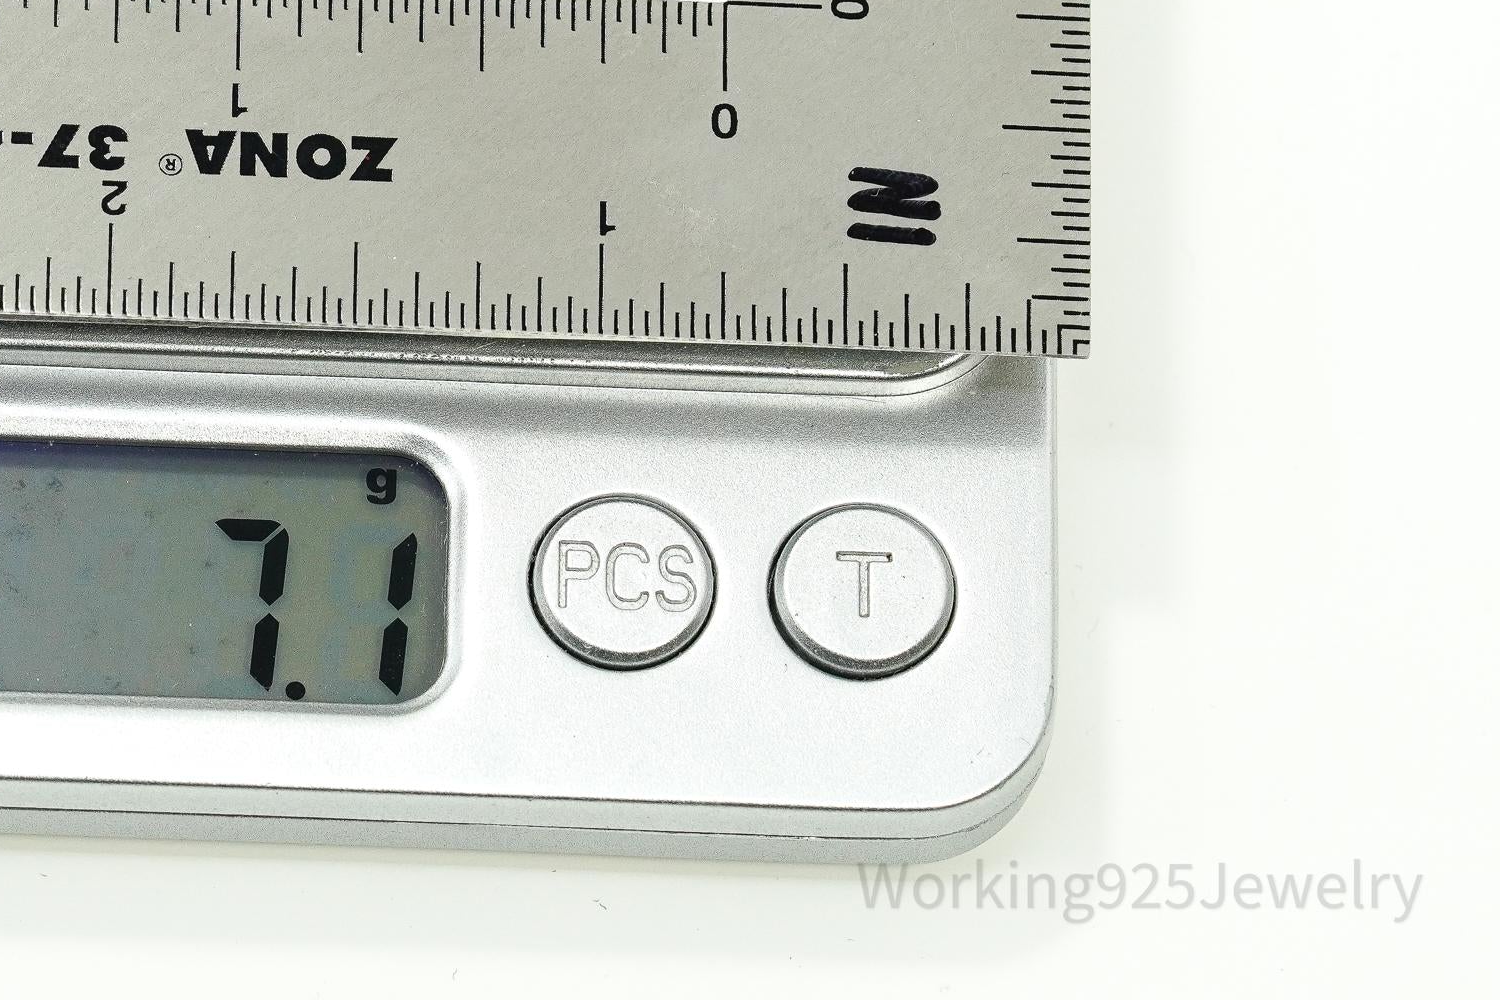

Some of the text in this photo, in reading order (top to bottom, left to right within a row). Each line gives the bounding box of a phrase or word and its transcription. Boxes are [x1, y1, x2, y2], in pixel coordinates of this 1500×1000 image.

[230, 81, 250, 119] 1
[710, 102, 740, 141] 0
[100, 179, 130, 217] 2
[598, 199, 618, 238] 1
[364, 466, 398, 506] g
[557, 538, 699, 614] PCS
[834, 549, 895, 620] T
[213, 517, 419, 702] 7.1
